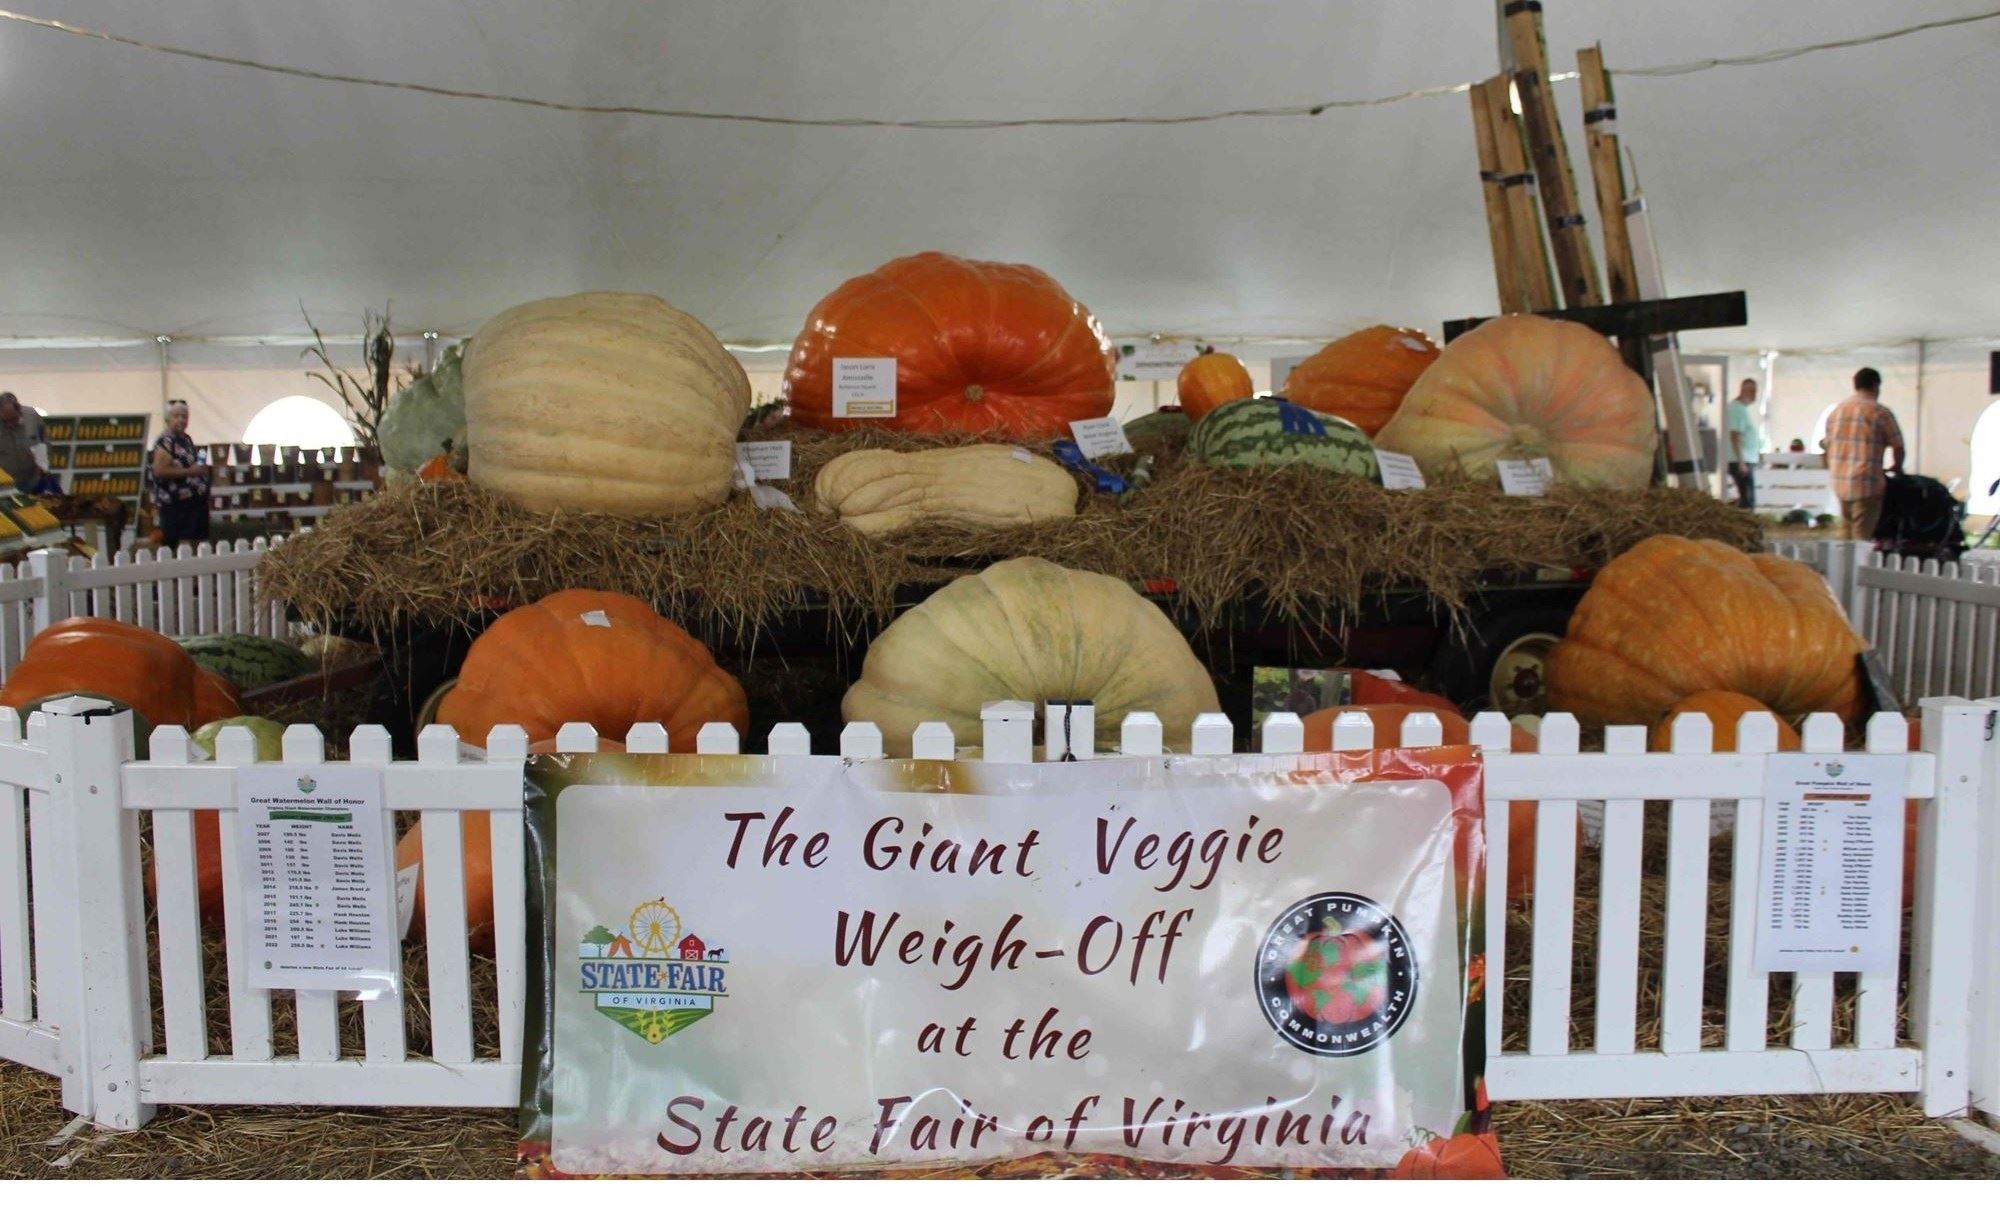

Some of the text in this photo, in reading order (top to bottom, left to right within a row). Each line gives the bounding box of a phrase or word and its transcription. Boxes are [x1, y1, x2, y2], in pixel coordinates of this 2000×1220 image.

[725, 807, 1283, 892] The Giant Veggie
[836, 909, 1193, 990] Weigh-Off
[1268, 902, 1405, 960] GREAT PUMPKIN
[581, 962, 727, 993] STATE FAIR
[612, 997, 696, 1006] OF VIRGINIA
[918, 1008, 1091, 1060] at the
[1271, 990, 1405, 1044] COMMONWEALTH
[657, 1096, 1369, 1163] State Fair of Virginia
